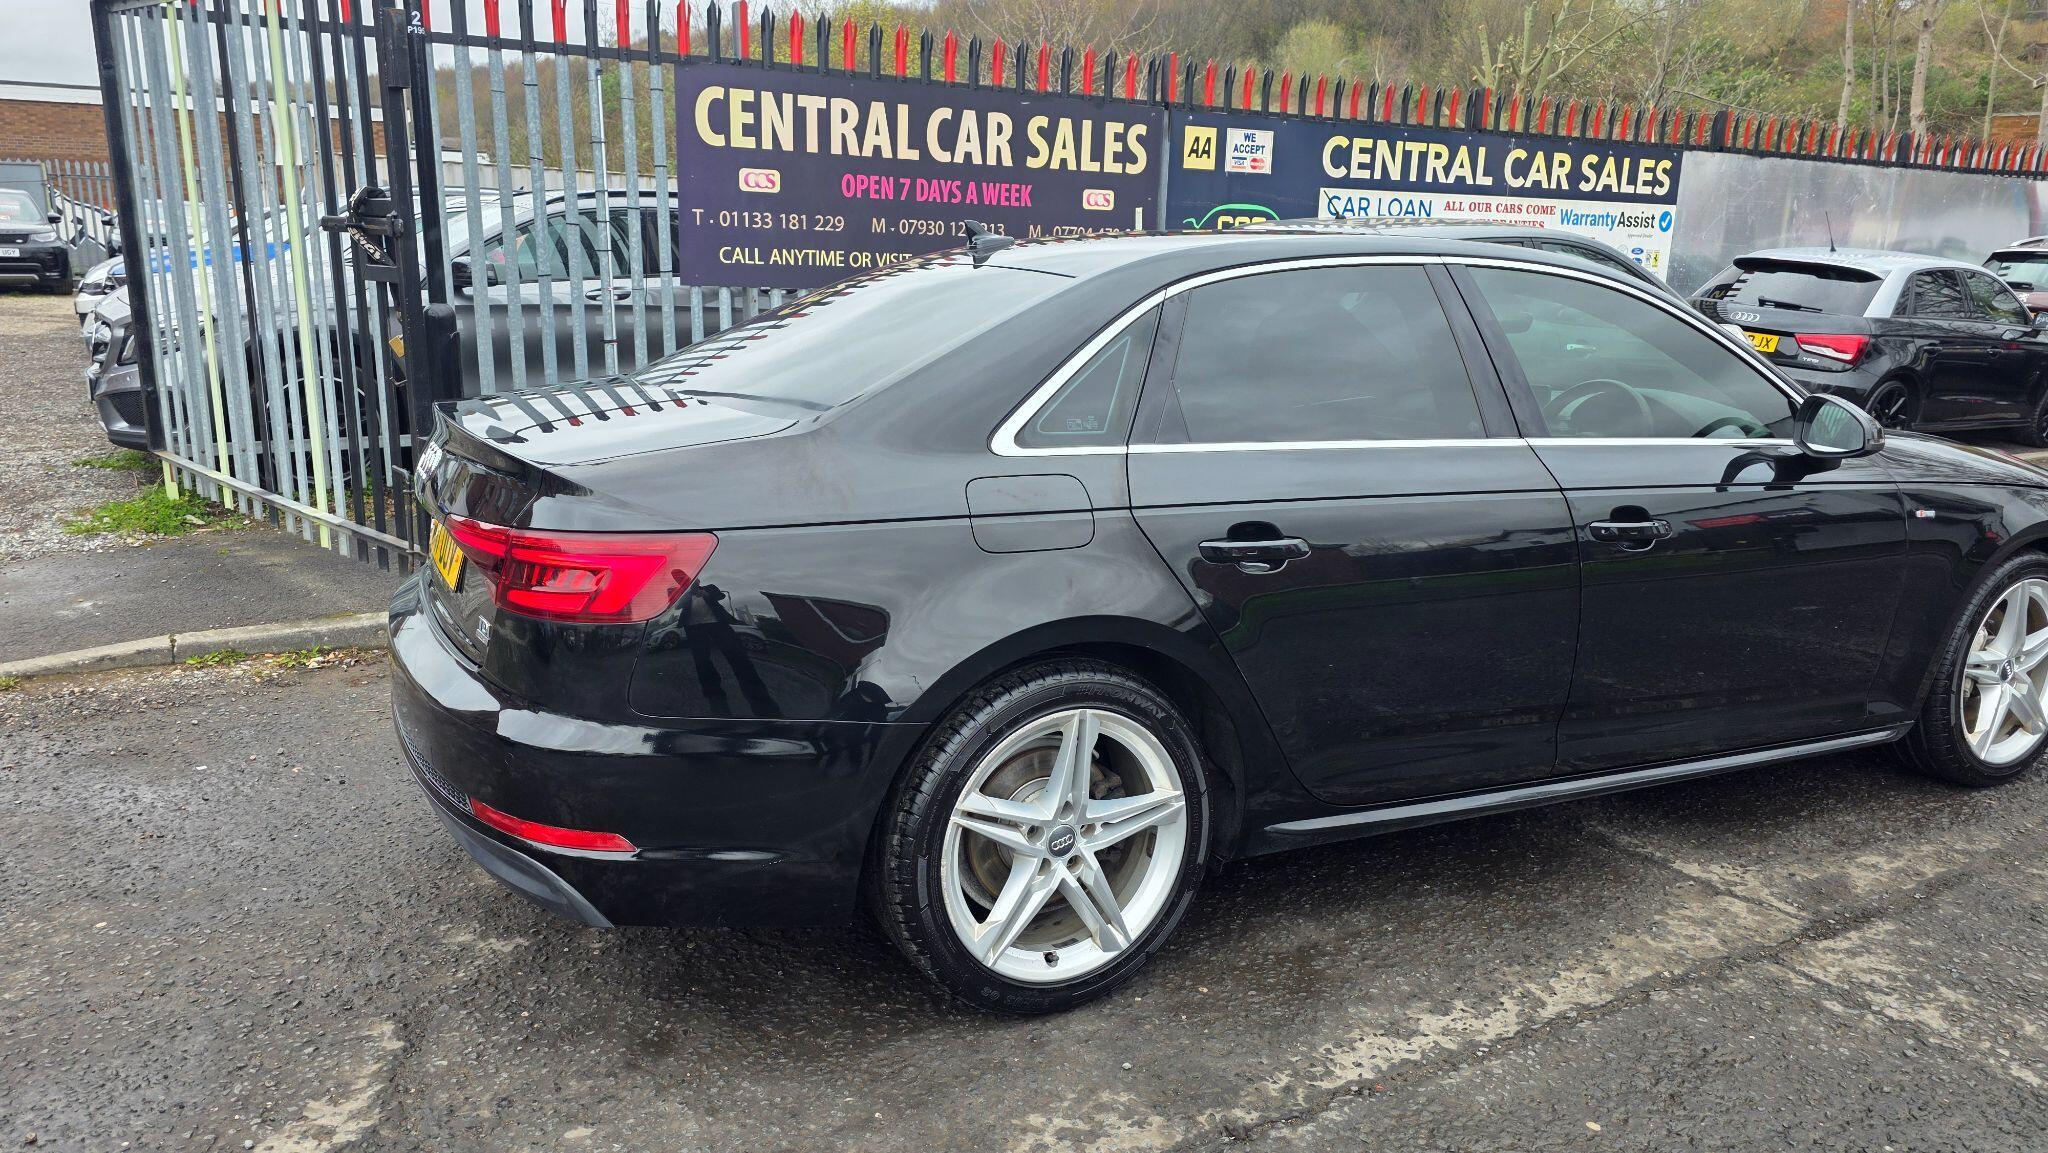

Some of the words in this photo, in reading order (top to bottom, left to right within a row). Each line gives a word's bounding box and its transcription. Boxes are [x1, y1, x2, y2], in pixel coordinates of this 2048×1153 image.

[411, 10, 421, 25] 2
[695, 86, 920, 161] CENTRAL
[926, 107, 1013, 167] CAR
[1026, 115, 1148, 175] SALES
[1243, 132, 1257, 143] WE
[1188, 136, 1212, 159] AA
[1232, 144, 1266, 155] ACCEPT
[1322, 135, 1493, 186] CENTRAL
[1504, 148, 1572, 190] CAR
[1578, 154, 1673, 196] SALES
[841, 173, 894, 200] OPEN
[900, 178, 911, 201] 7
[916, 178, 962, 204] DAYS
[965, 181, 978, 205] A
[982, 182, 1033, 207] WEEK
[1327, 195, 1371, 217] CAR
[1378, 197, 1433, 218] LOAN
[1444, 201, 1465, 212] ALL
[1469, 201, 1492, 213] OUR
[1496, 203, 1523, 214] CARS
[1526, 204, 1557, 216] COME
[719, 211, 773, 228] 01133
[779, 213, 807, 230] 181
[814, 215, 845, 232] 229
[899, 219, 945, 236] 07930
[719, 246, 765, 265] CALL
[769, 248, 845, 267] ANYTIME
[849, 252, 872, 268] OR
